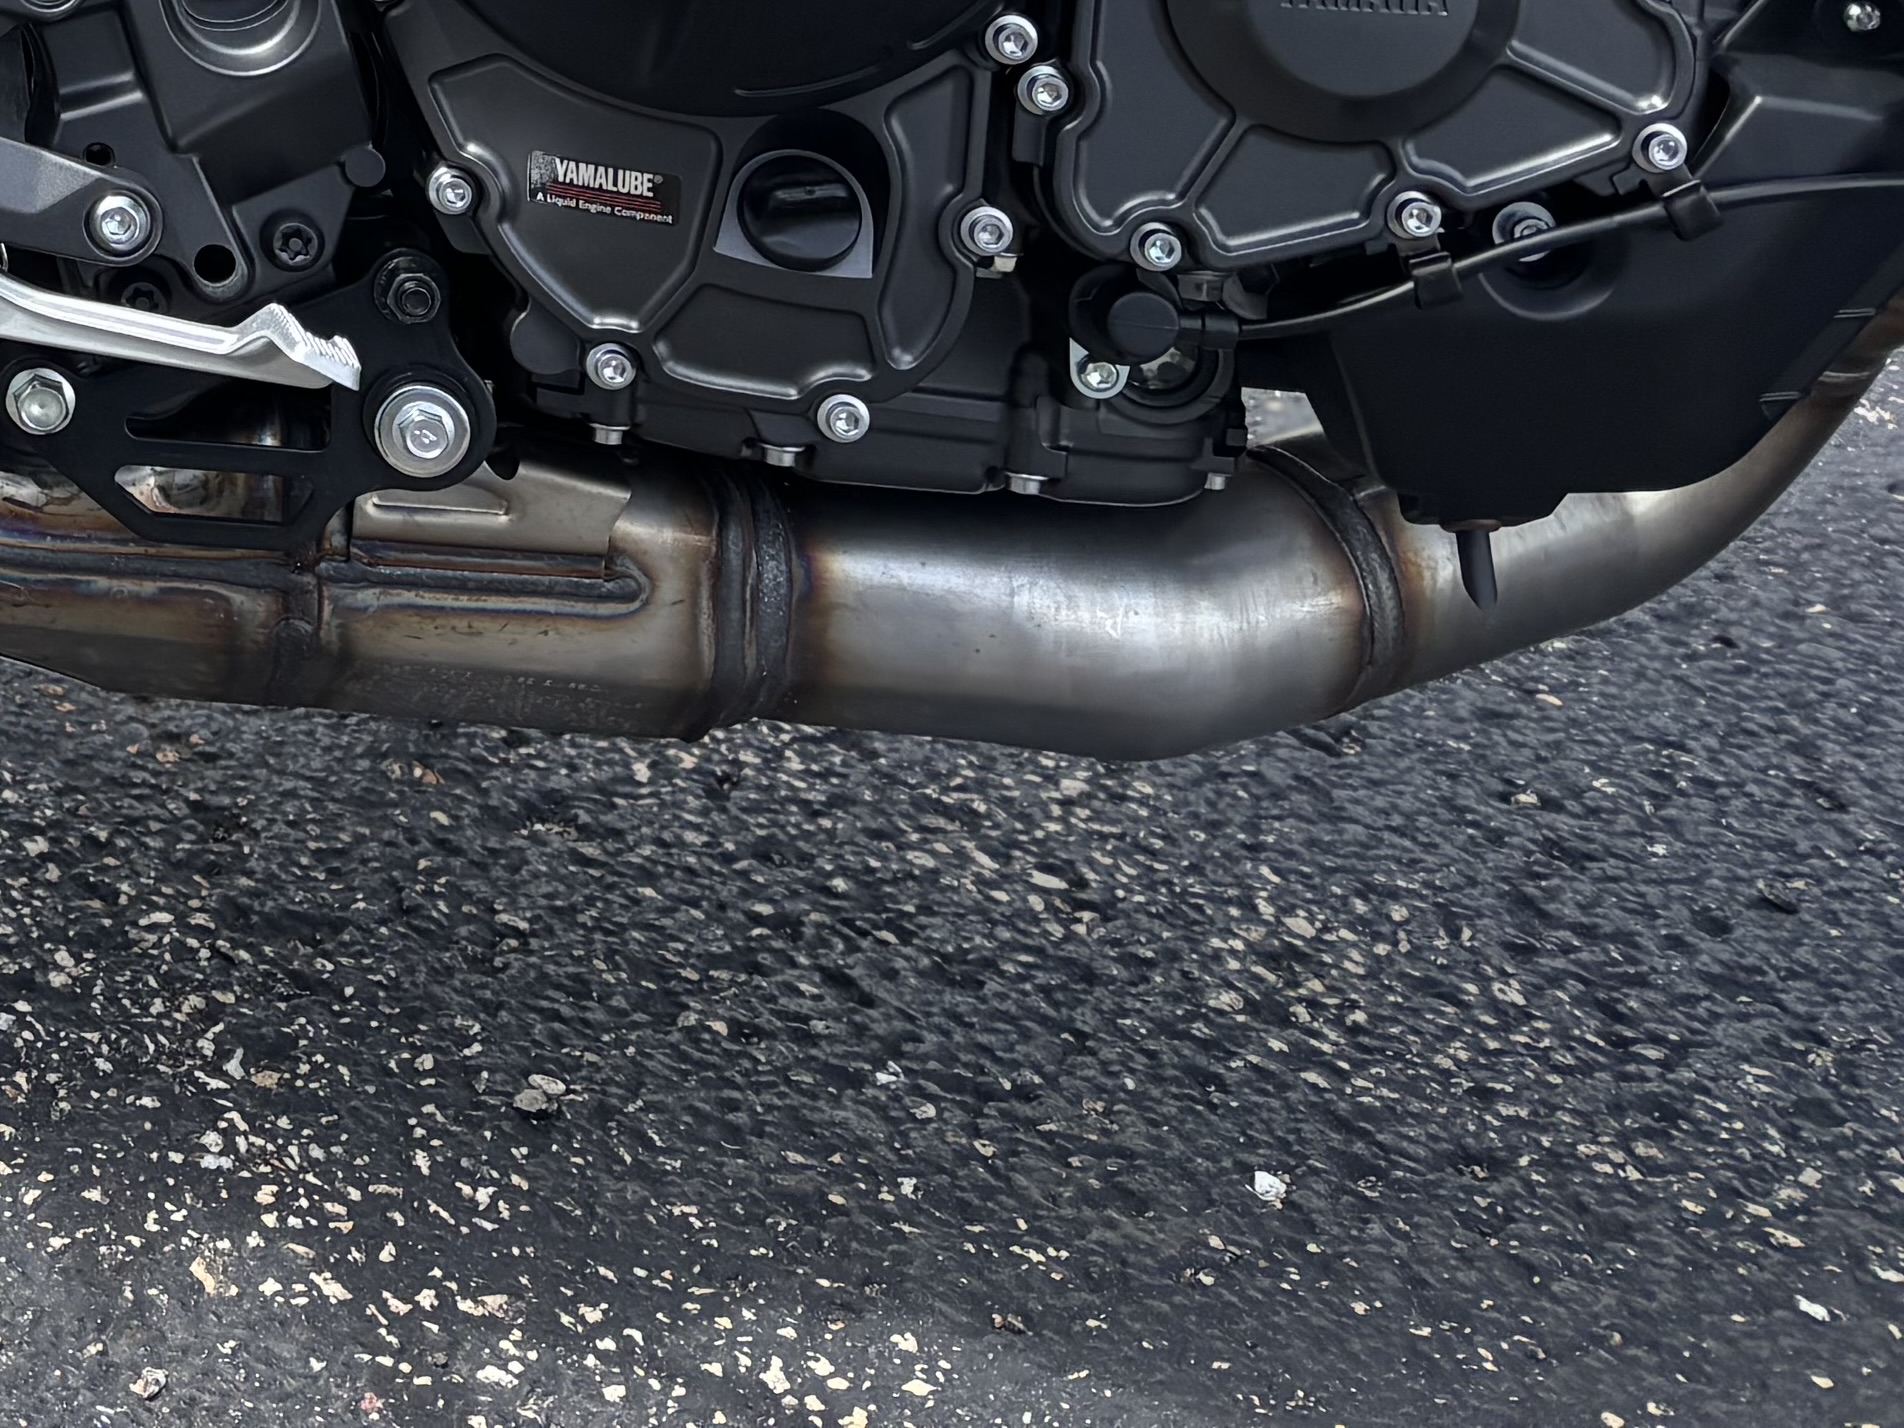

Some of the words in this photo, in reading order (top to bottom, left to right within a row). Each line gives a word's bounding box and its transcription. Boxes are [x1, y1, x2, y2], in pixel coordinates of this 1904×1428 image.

[555, 157, 654, 196] YAMALUBE
[547, 194, 577, 209] Liquid
[579, 199, 612, 215] Engine
